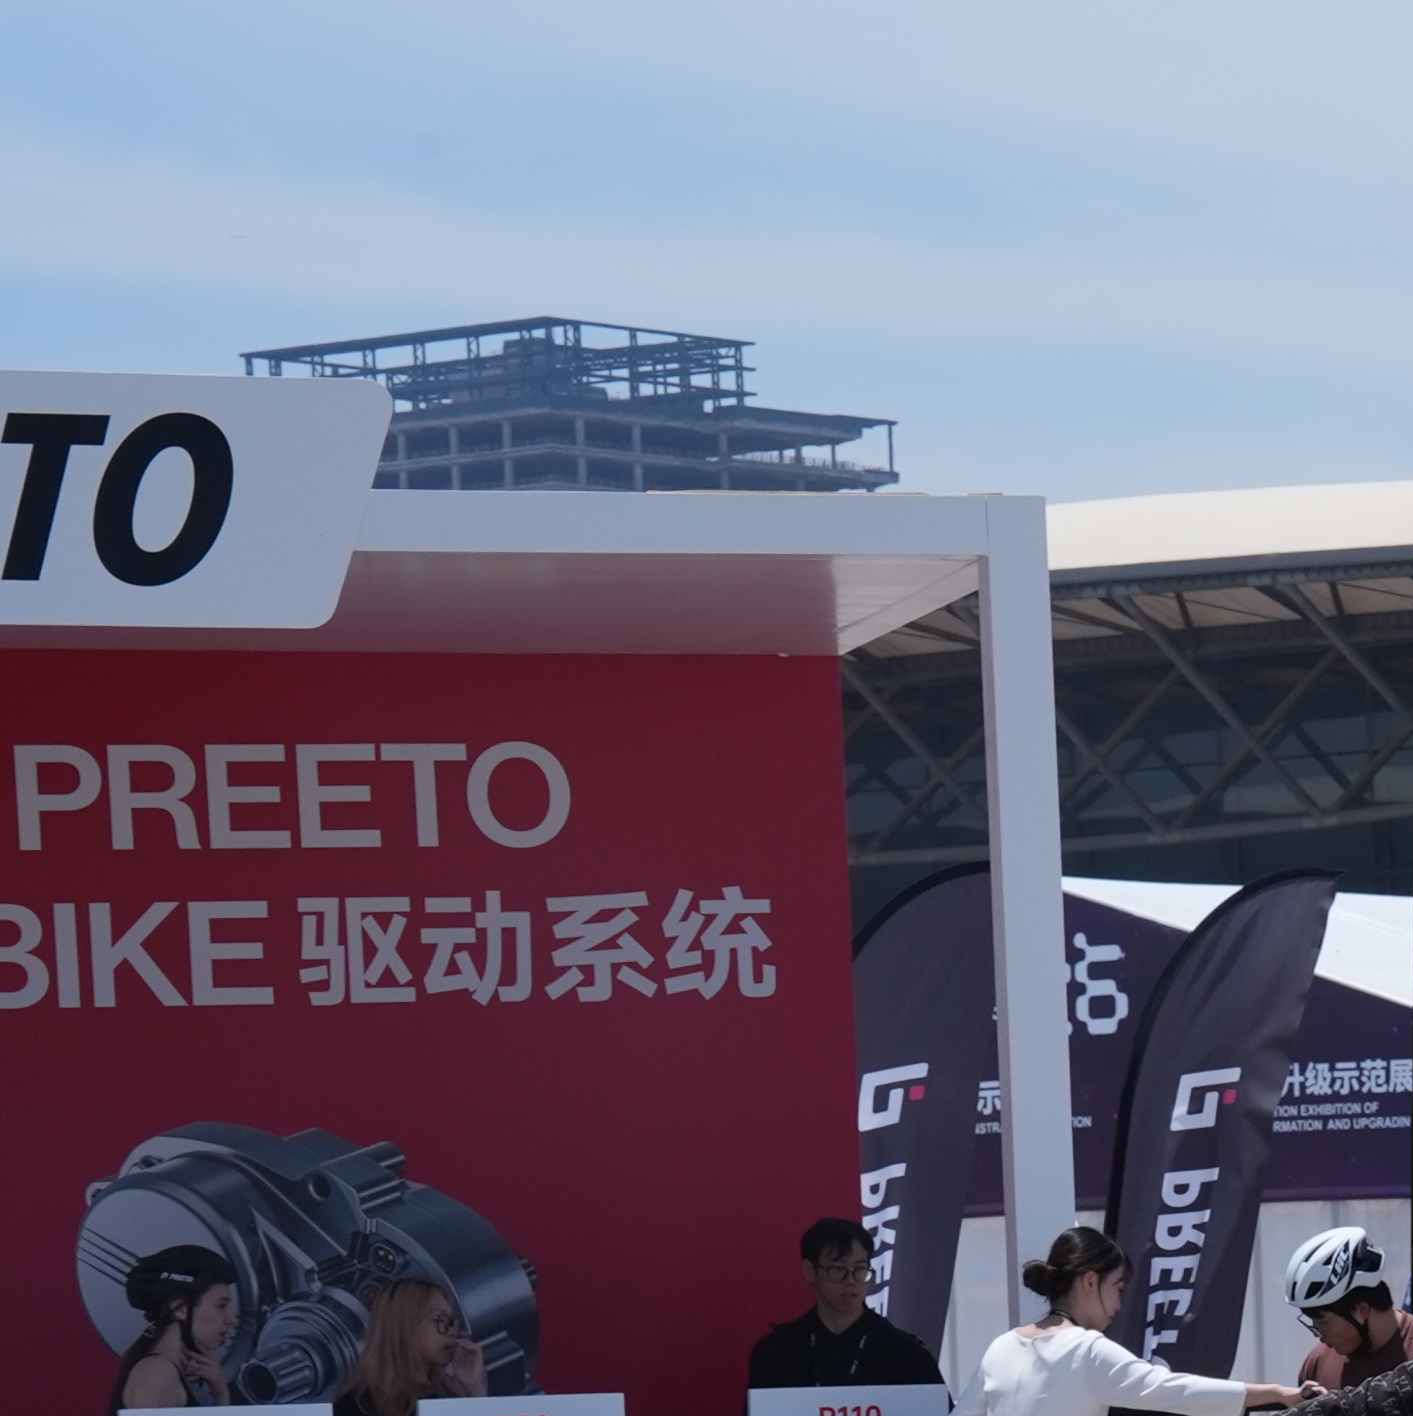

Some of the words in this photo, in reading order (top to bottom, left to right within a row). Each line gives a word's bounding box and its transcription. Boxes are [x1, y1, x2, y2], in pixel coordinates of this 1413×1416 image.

[0, 412, 234, 587] TO
[13, 741, 571, 852] PREETO
[297, 887, 778, 1007] 驱动系统
[1300, 1103, 1362, 1117] EXHIBITION
[1364, 1101, 1380, 1115] OF
[1326, 1118, 1351, 1131] AND
[1354, 1115, 1412, 1130] UPGRADIN
